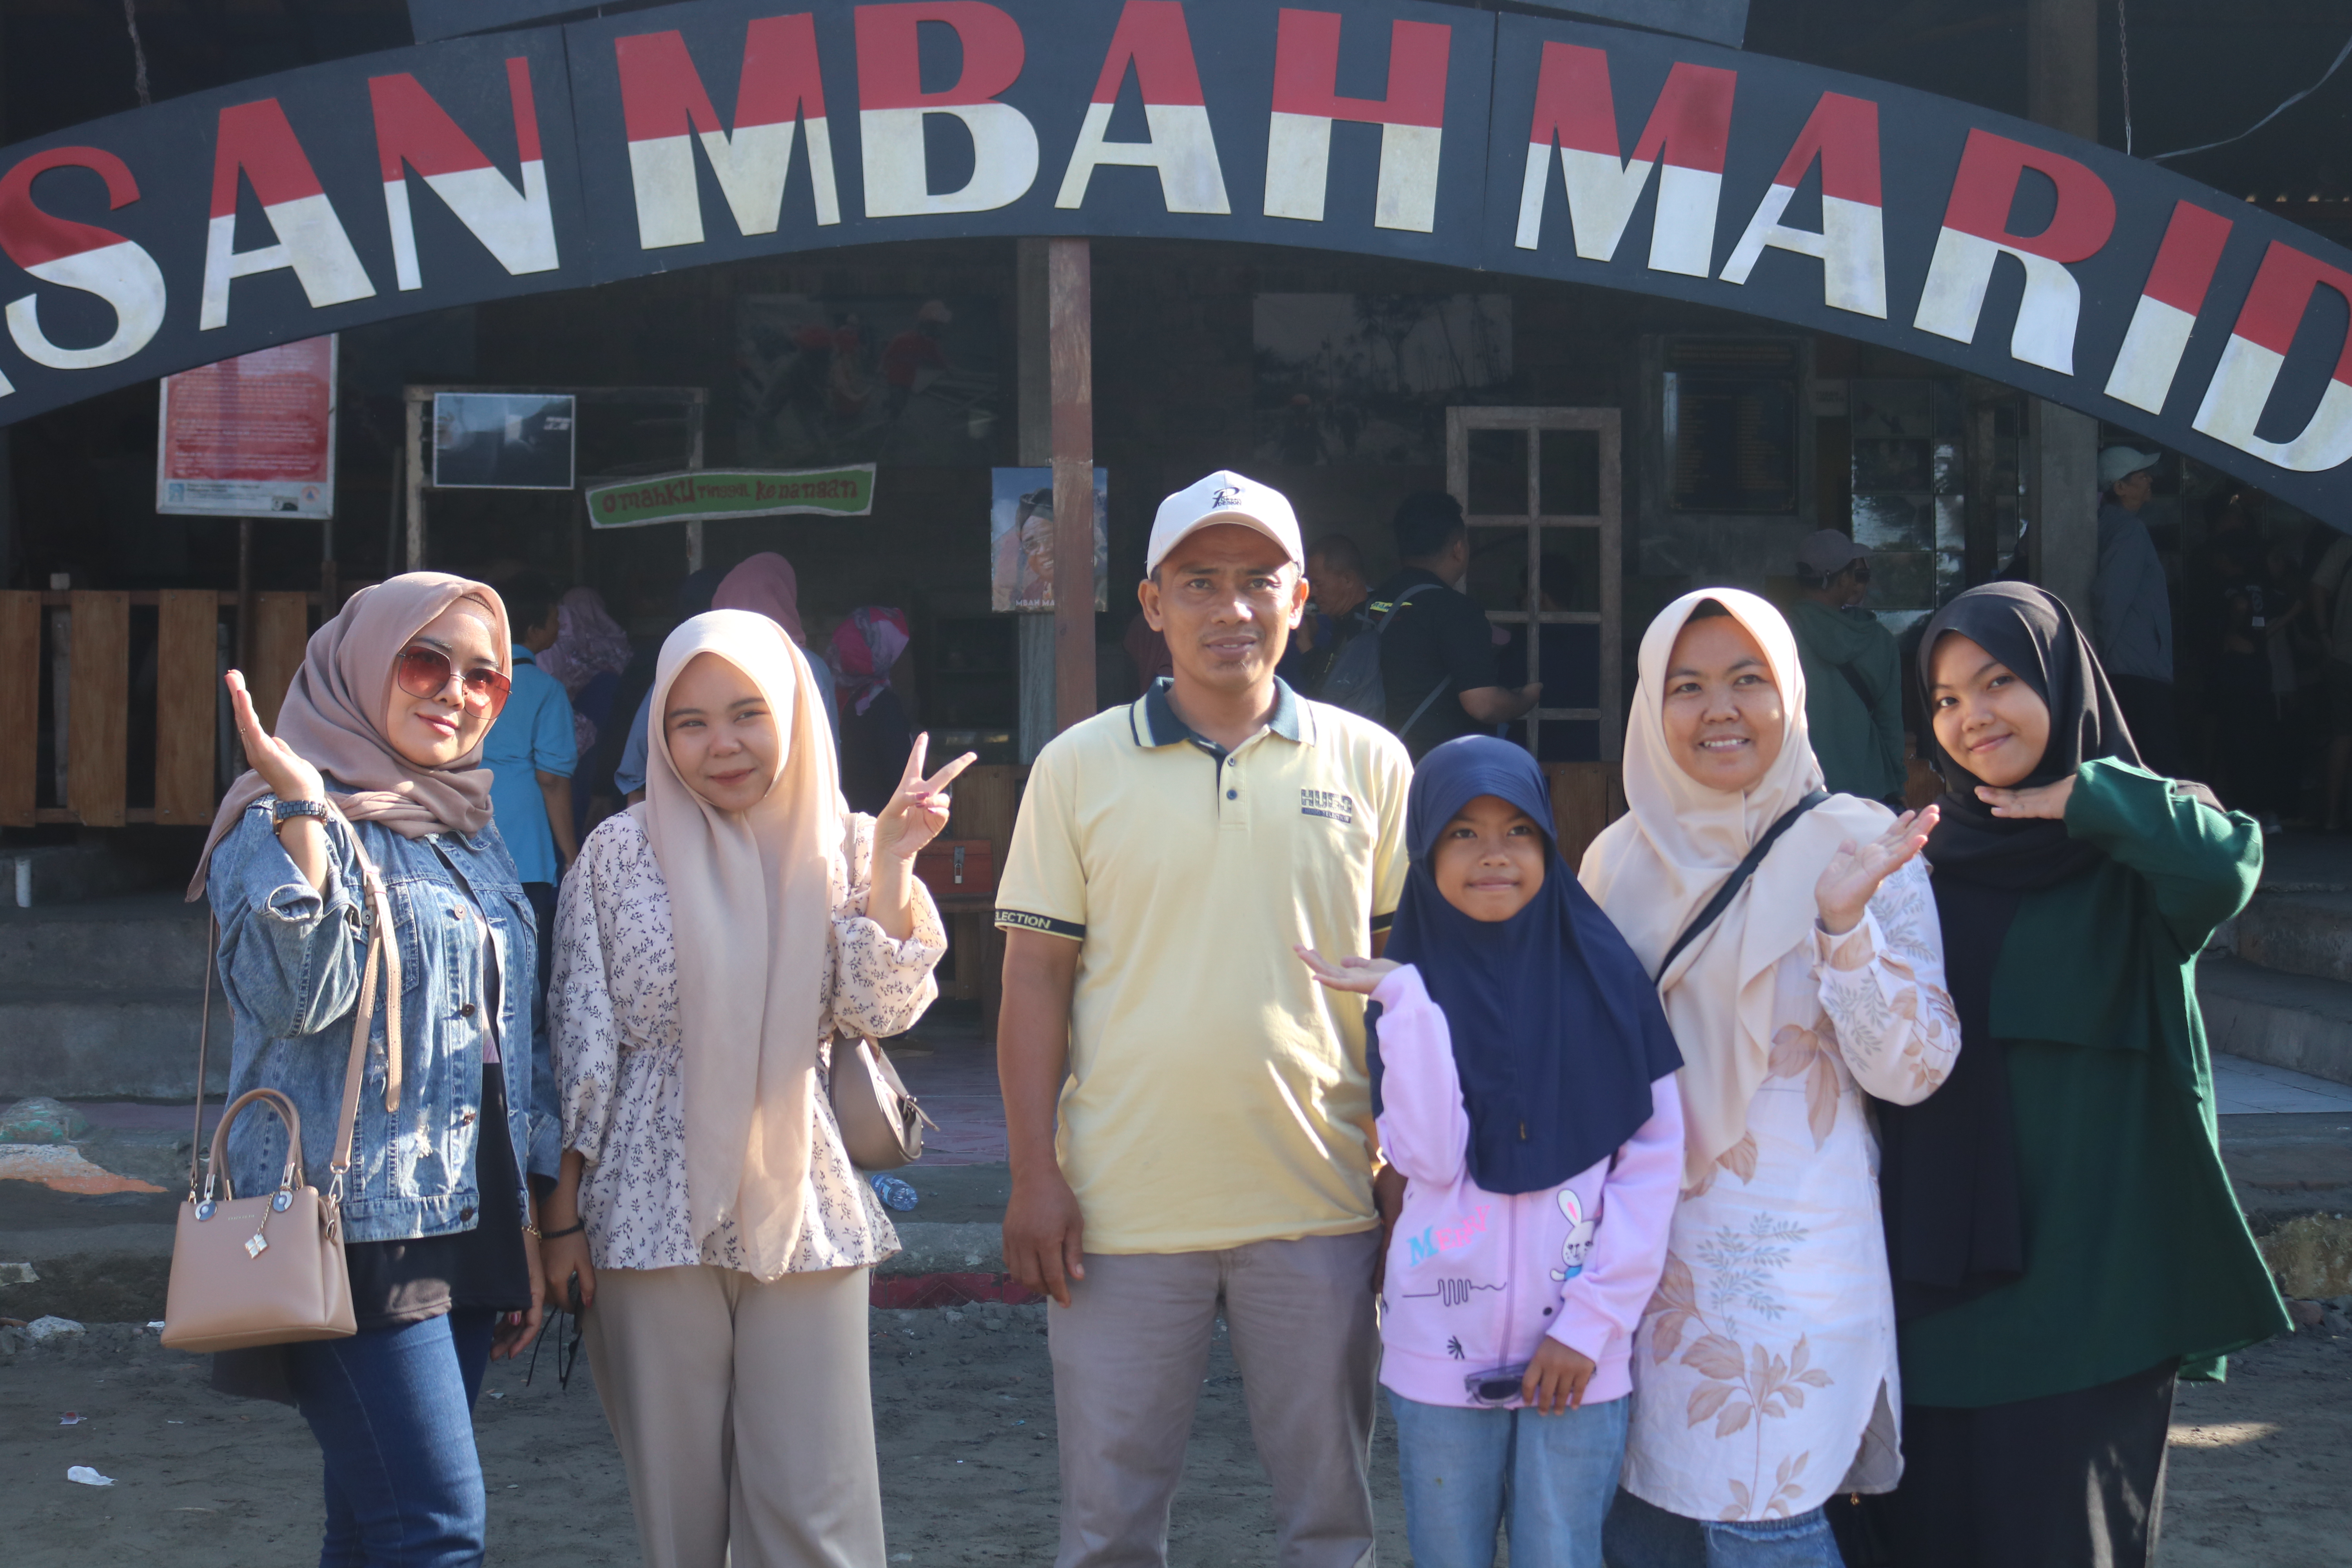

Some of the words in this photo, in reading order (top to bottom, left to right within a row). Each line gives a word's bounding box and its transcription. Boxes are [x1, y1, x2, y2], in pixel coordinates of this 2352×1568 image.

[0, 57, 559, 394] SAN
[615, 0, 1451, 250] MBAH
[1515, 40, 2352, 472] MARID
[755, 479, 857, 501] kenangan
[1322, 811, 1349, 822] SELECTION
[1406, 1205, 1490, 1267] MERRY
